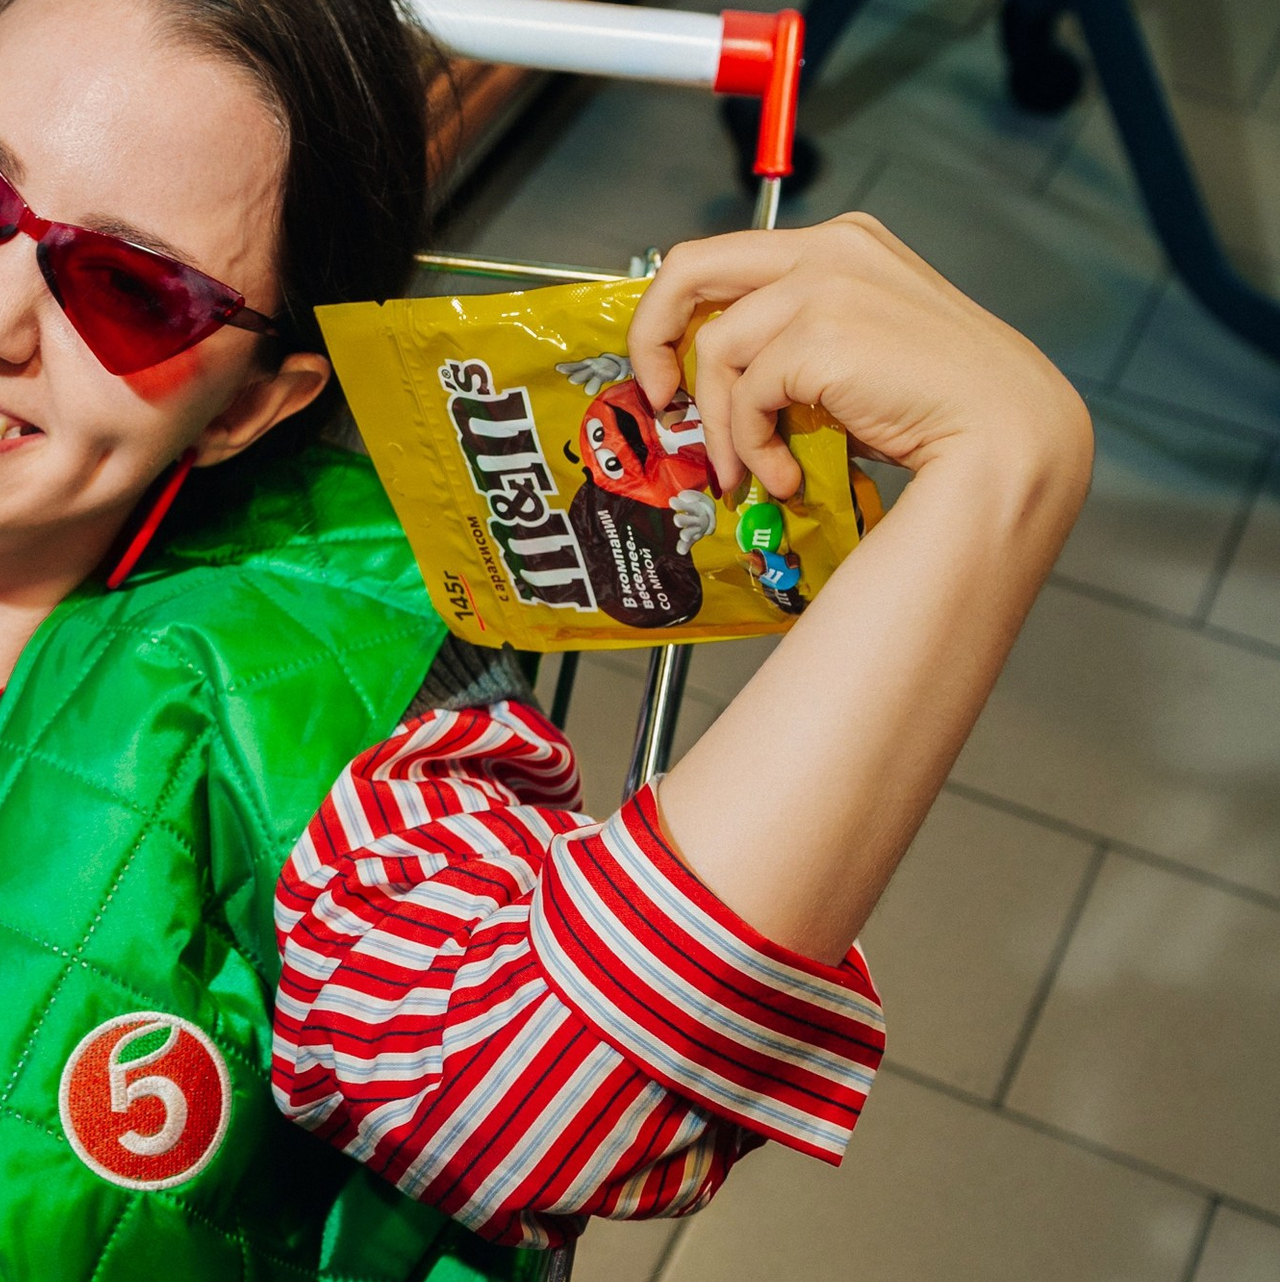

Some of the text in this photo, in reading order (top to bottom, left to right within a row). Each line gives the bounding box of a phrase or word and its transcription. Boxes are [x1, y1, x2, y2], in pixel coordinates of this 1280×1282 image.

[467, 516, 508, 592] арахисом
[597, 509, 638, 608] В компании
[626, 525, 655, 609] веселее...
[639, 547, 671, 610] со мной
[444, 570, 474, 622] 145г
